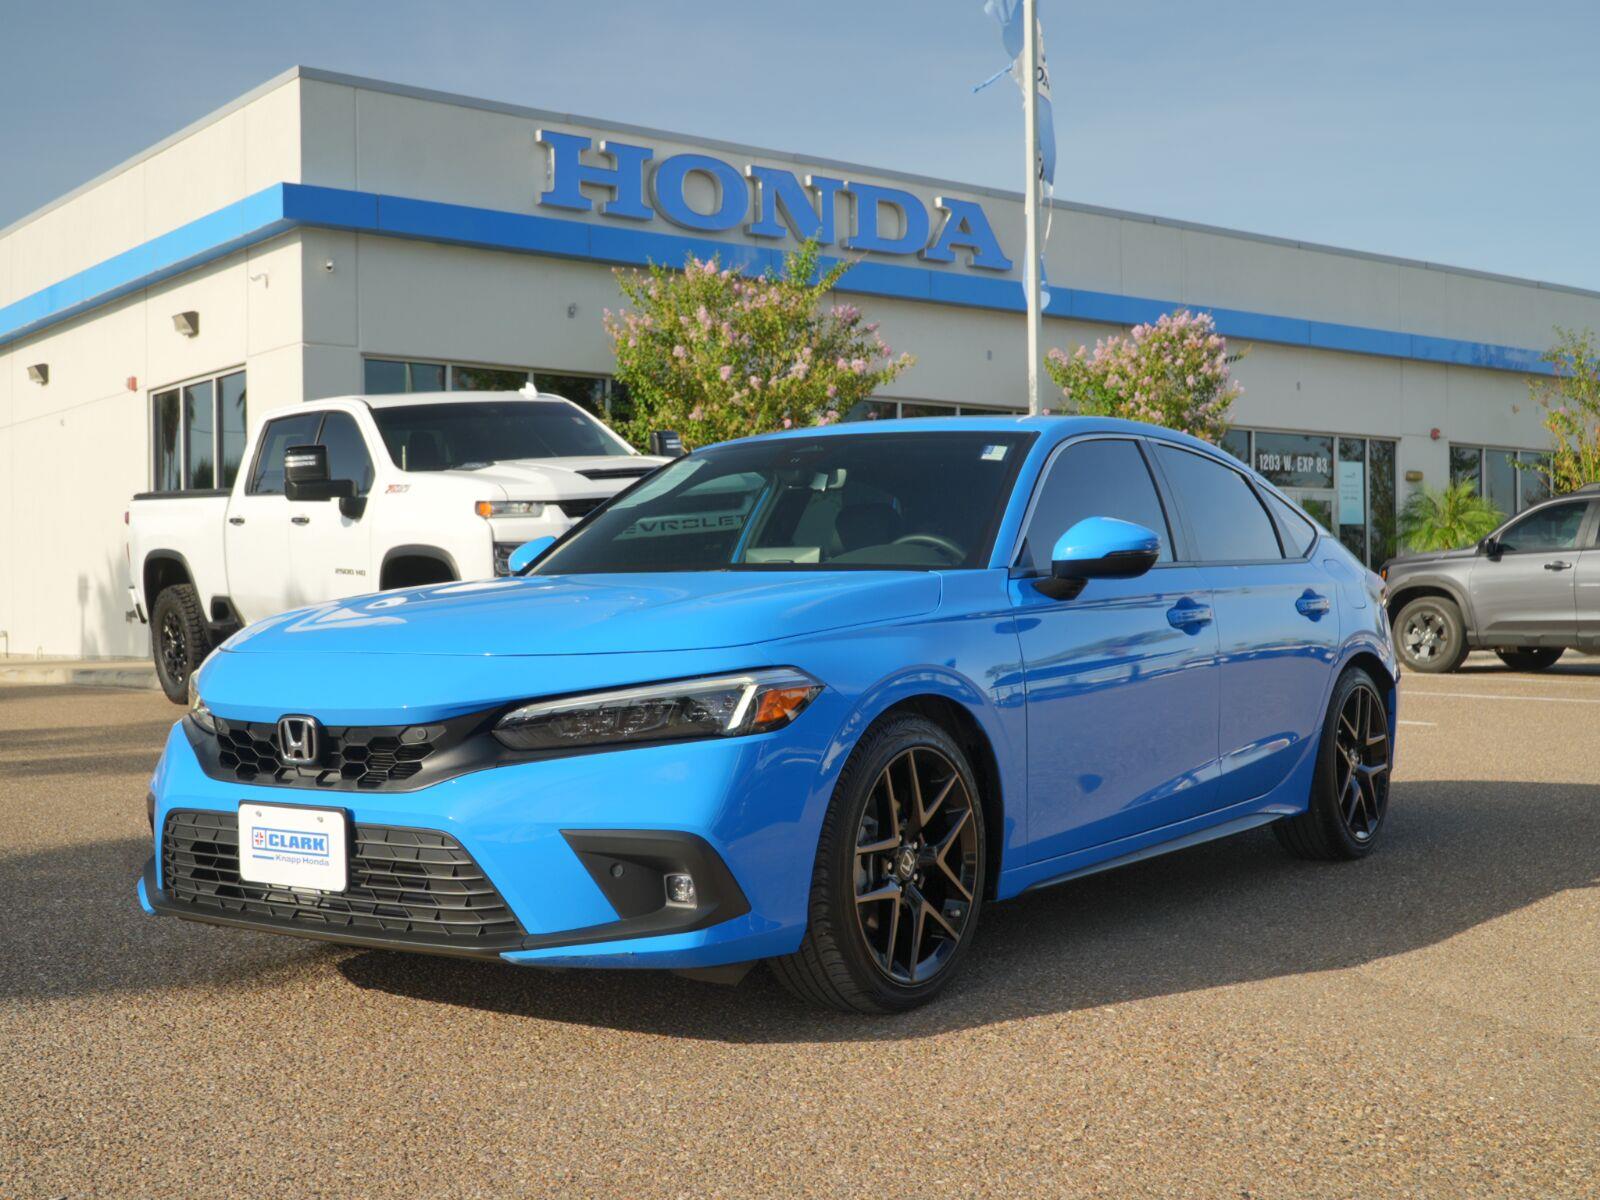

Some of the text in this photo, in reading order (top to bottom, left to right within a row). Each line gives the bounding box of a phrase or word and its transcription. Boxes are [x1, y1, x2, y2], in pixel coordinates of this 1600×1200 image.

[535, 128, 1013, 272] HONDA
[1260, 454, 1328, 473] 1203 W. EXP 83
[268, 833, 325, 851] CLARK
[275, 853, 330, 866] Knapp Honda
